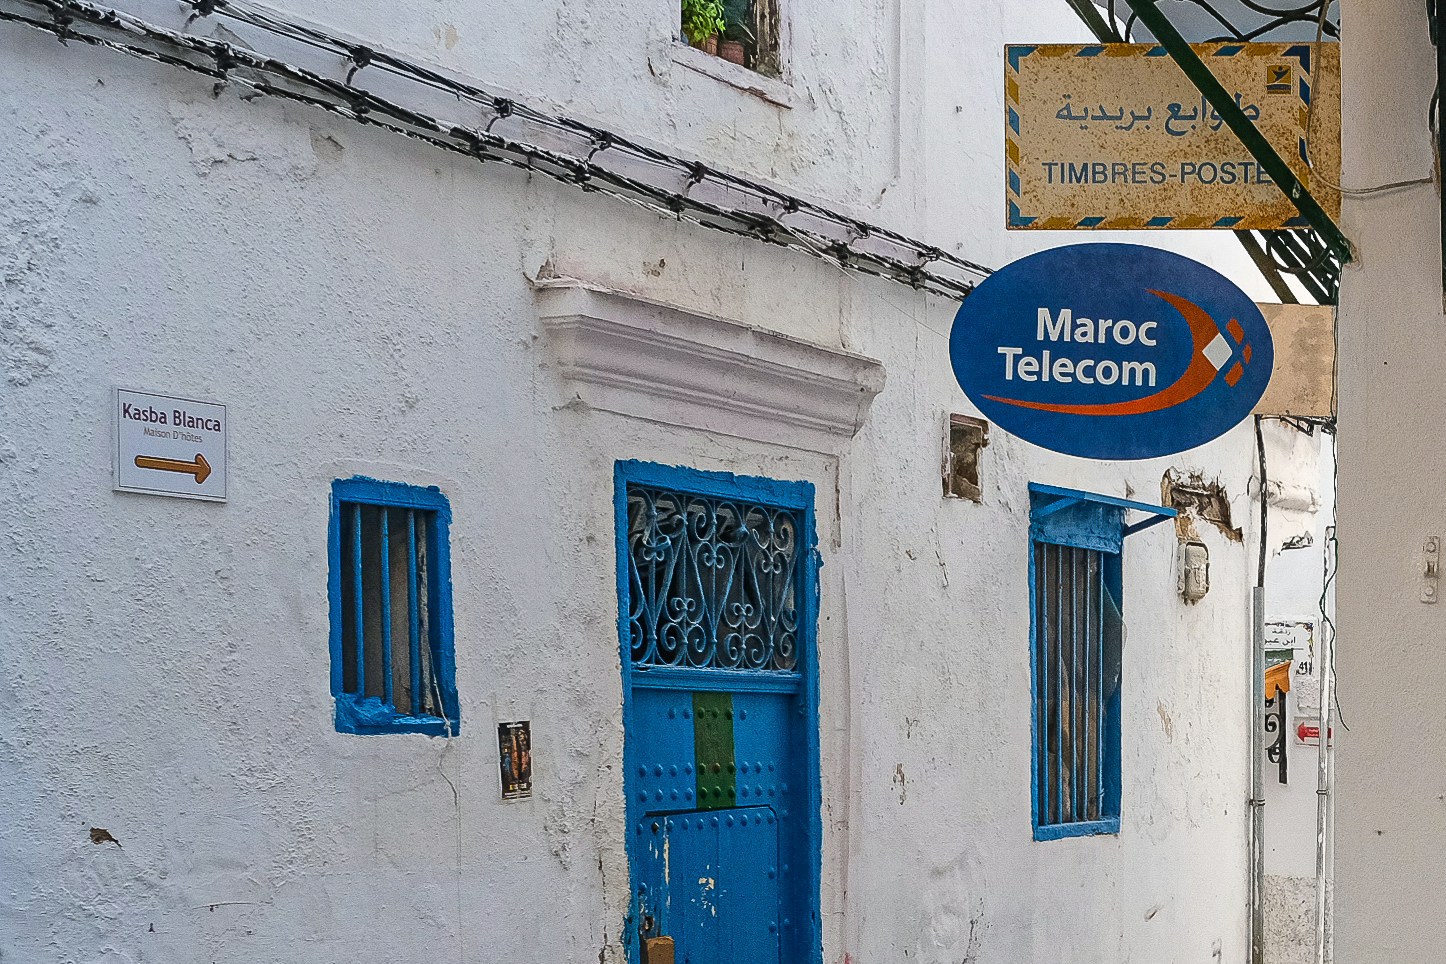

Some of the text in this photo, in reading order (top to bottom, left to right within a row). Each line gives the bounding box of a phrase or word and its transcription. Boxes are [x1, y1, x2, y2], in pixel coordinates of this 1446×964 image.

[1056, 94, 1152, 131] بريدية
[1041, 161, 1273, 185] TIMBRES-POSTE
[1036, 307, 1157, 346] Maroc
[997, 346, 1157, 387] Telecom
[122, 402, 221, 432] Kasba Blanca
[143, 427, 171, 439] Maison
